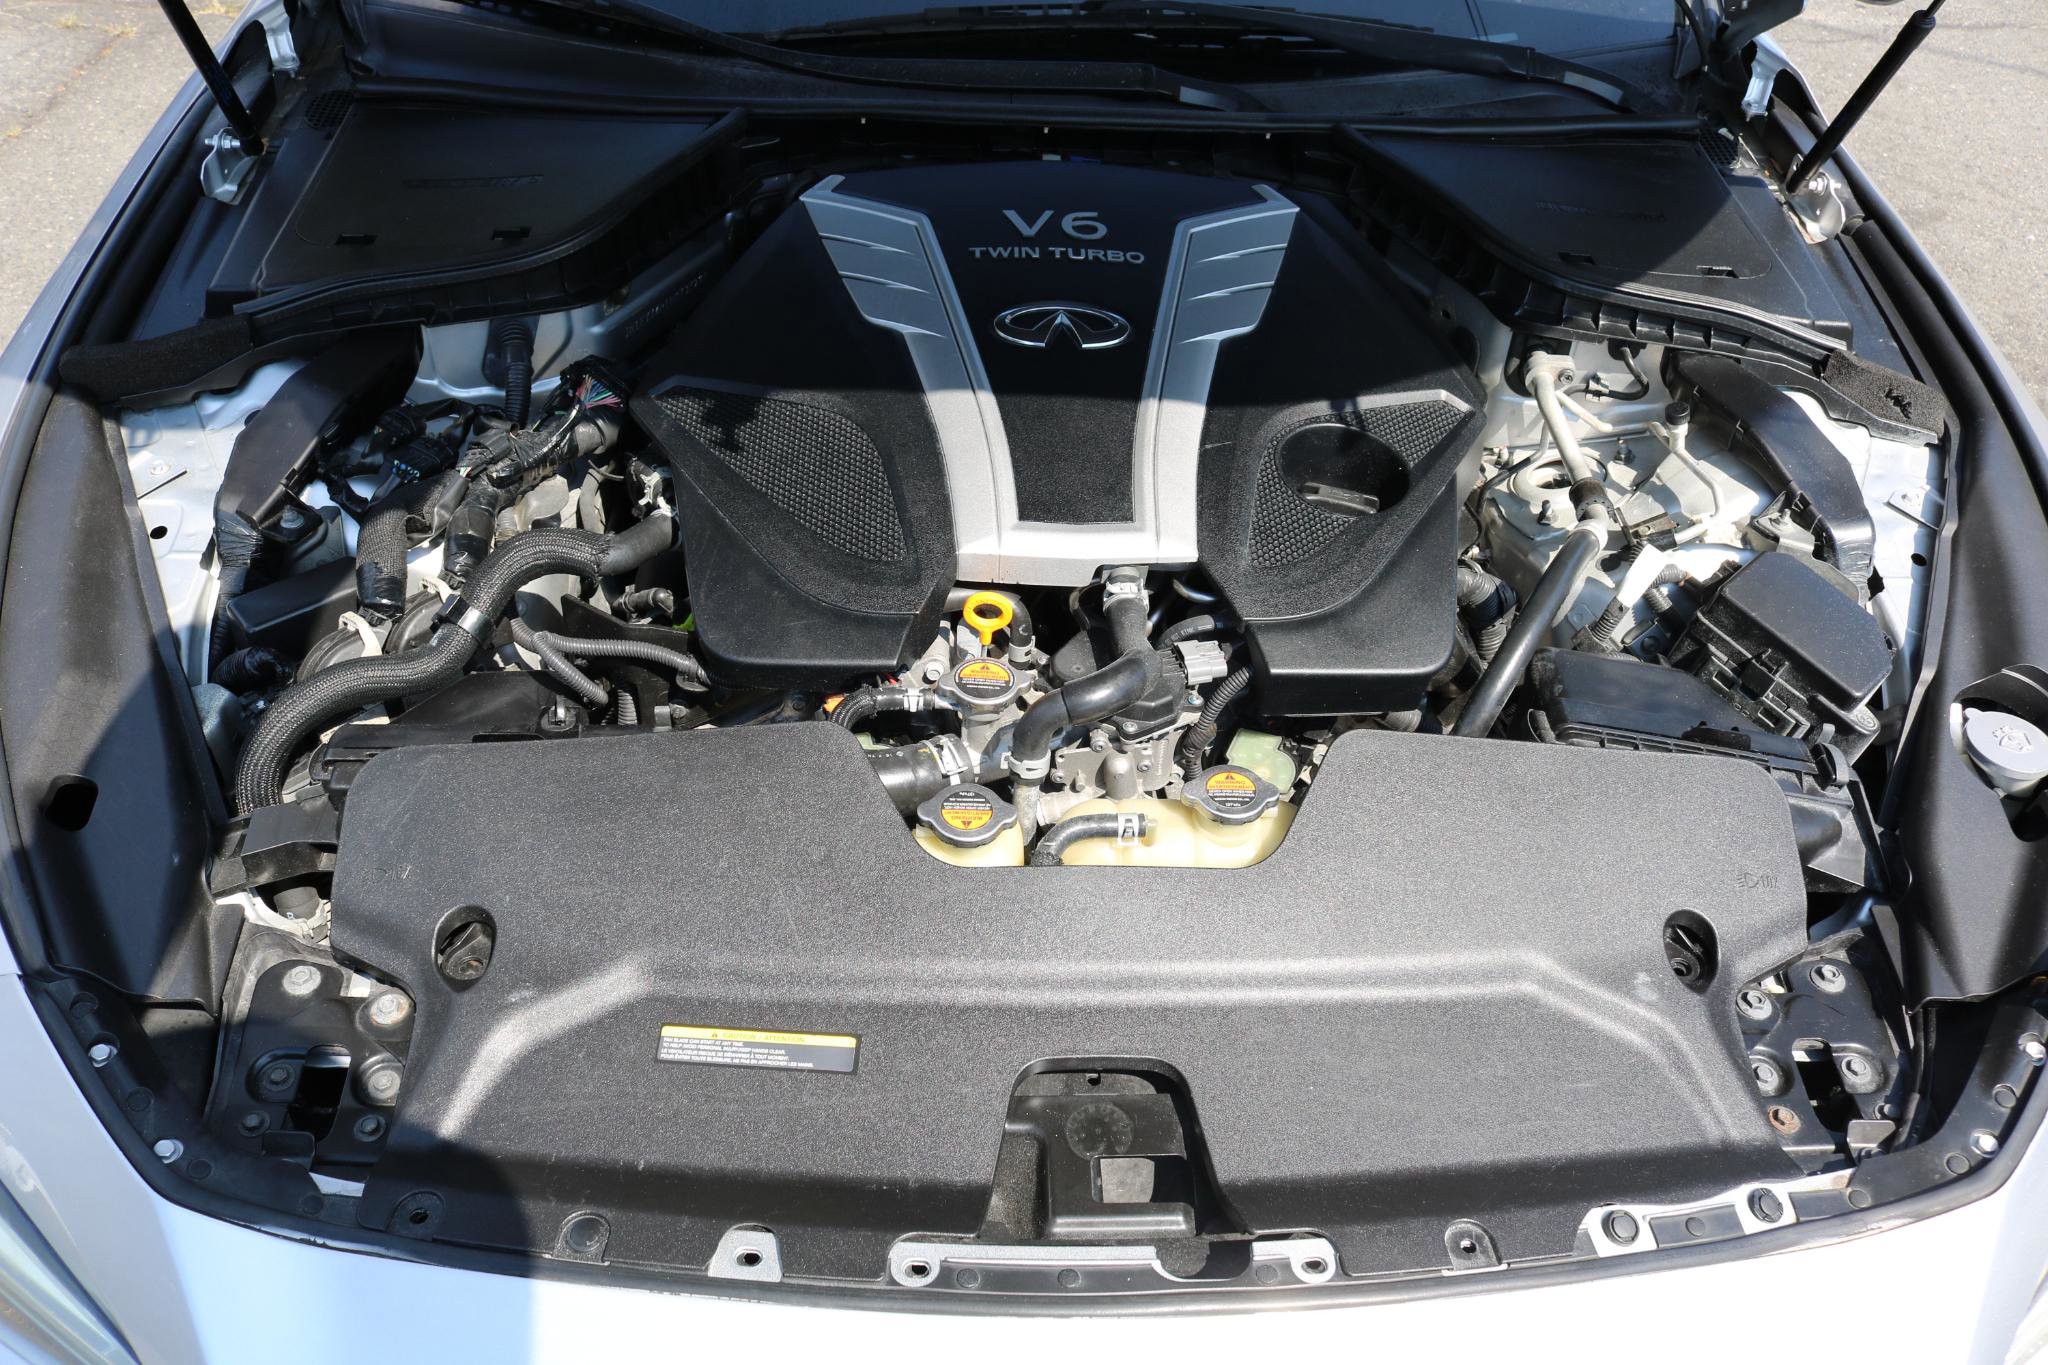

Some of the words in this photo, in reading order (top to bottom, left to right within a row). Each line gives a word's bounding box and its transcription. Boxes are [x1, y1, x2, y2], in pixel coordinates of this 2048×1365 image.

[1002, 209, 1108, 240] V6
[969, 246, 1040, 259] TWIN
[1048, 247, 1145, 264] TURBO
[722, 1032, 757, 1040] CAUTION
[764, 1034, 806, 1042] ATTENTION
